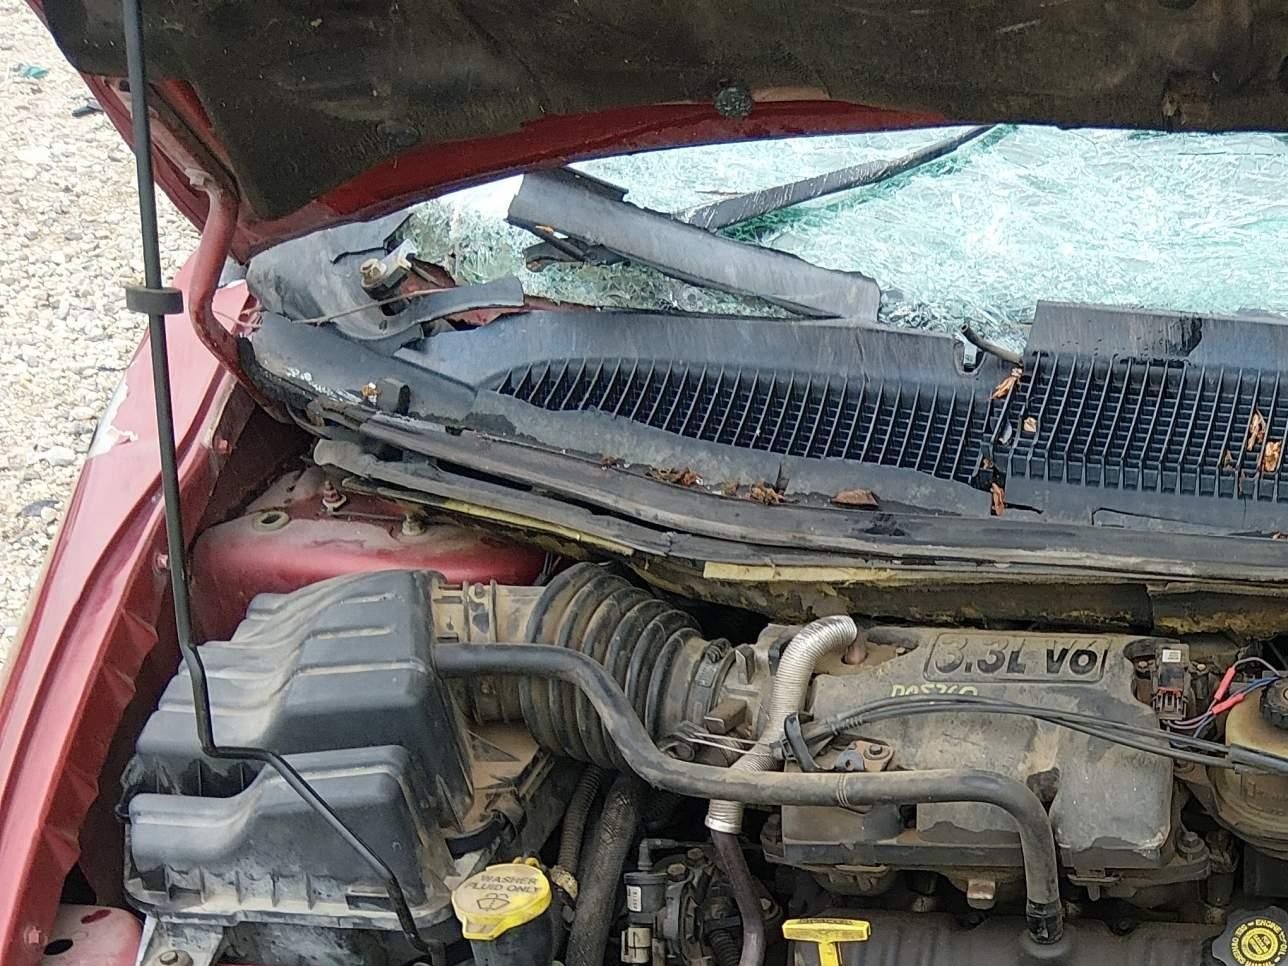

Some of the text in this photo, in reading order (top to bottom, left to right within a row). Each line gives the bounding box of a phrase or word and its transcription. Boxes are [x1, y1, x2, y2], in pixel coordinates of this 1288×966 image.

[935, 637, 1098, 676] 3.3L V6
[464, 882, 542, 893] FLUID ONLY
[480, 874, 538, 885] WASHER
[1255, 919, 1282, 934] ENGINE
[1278, 944, 1288, 955] OIL
